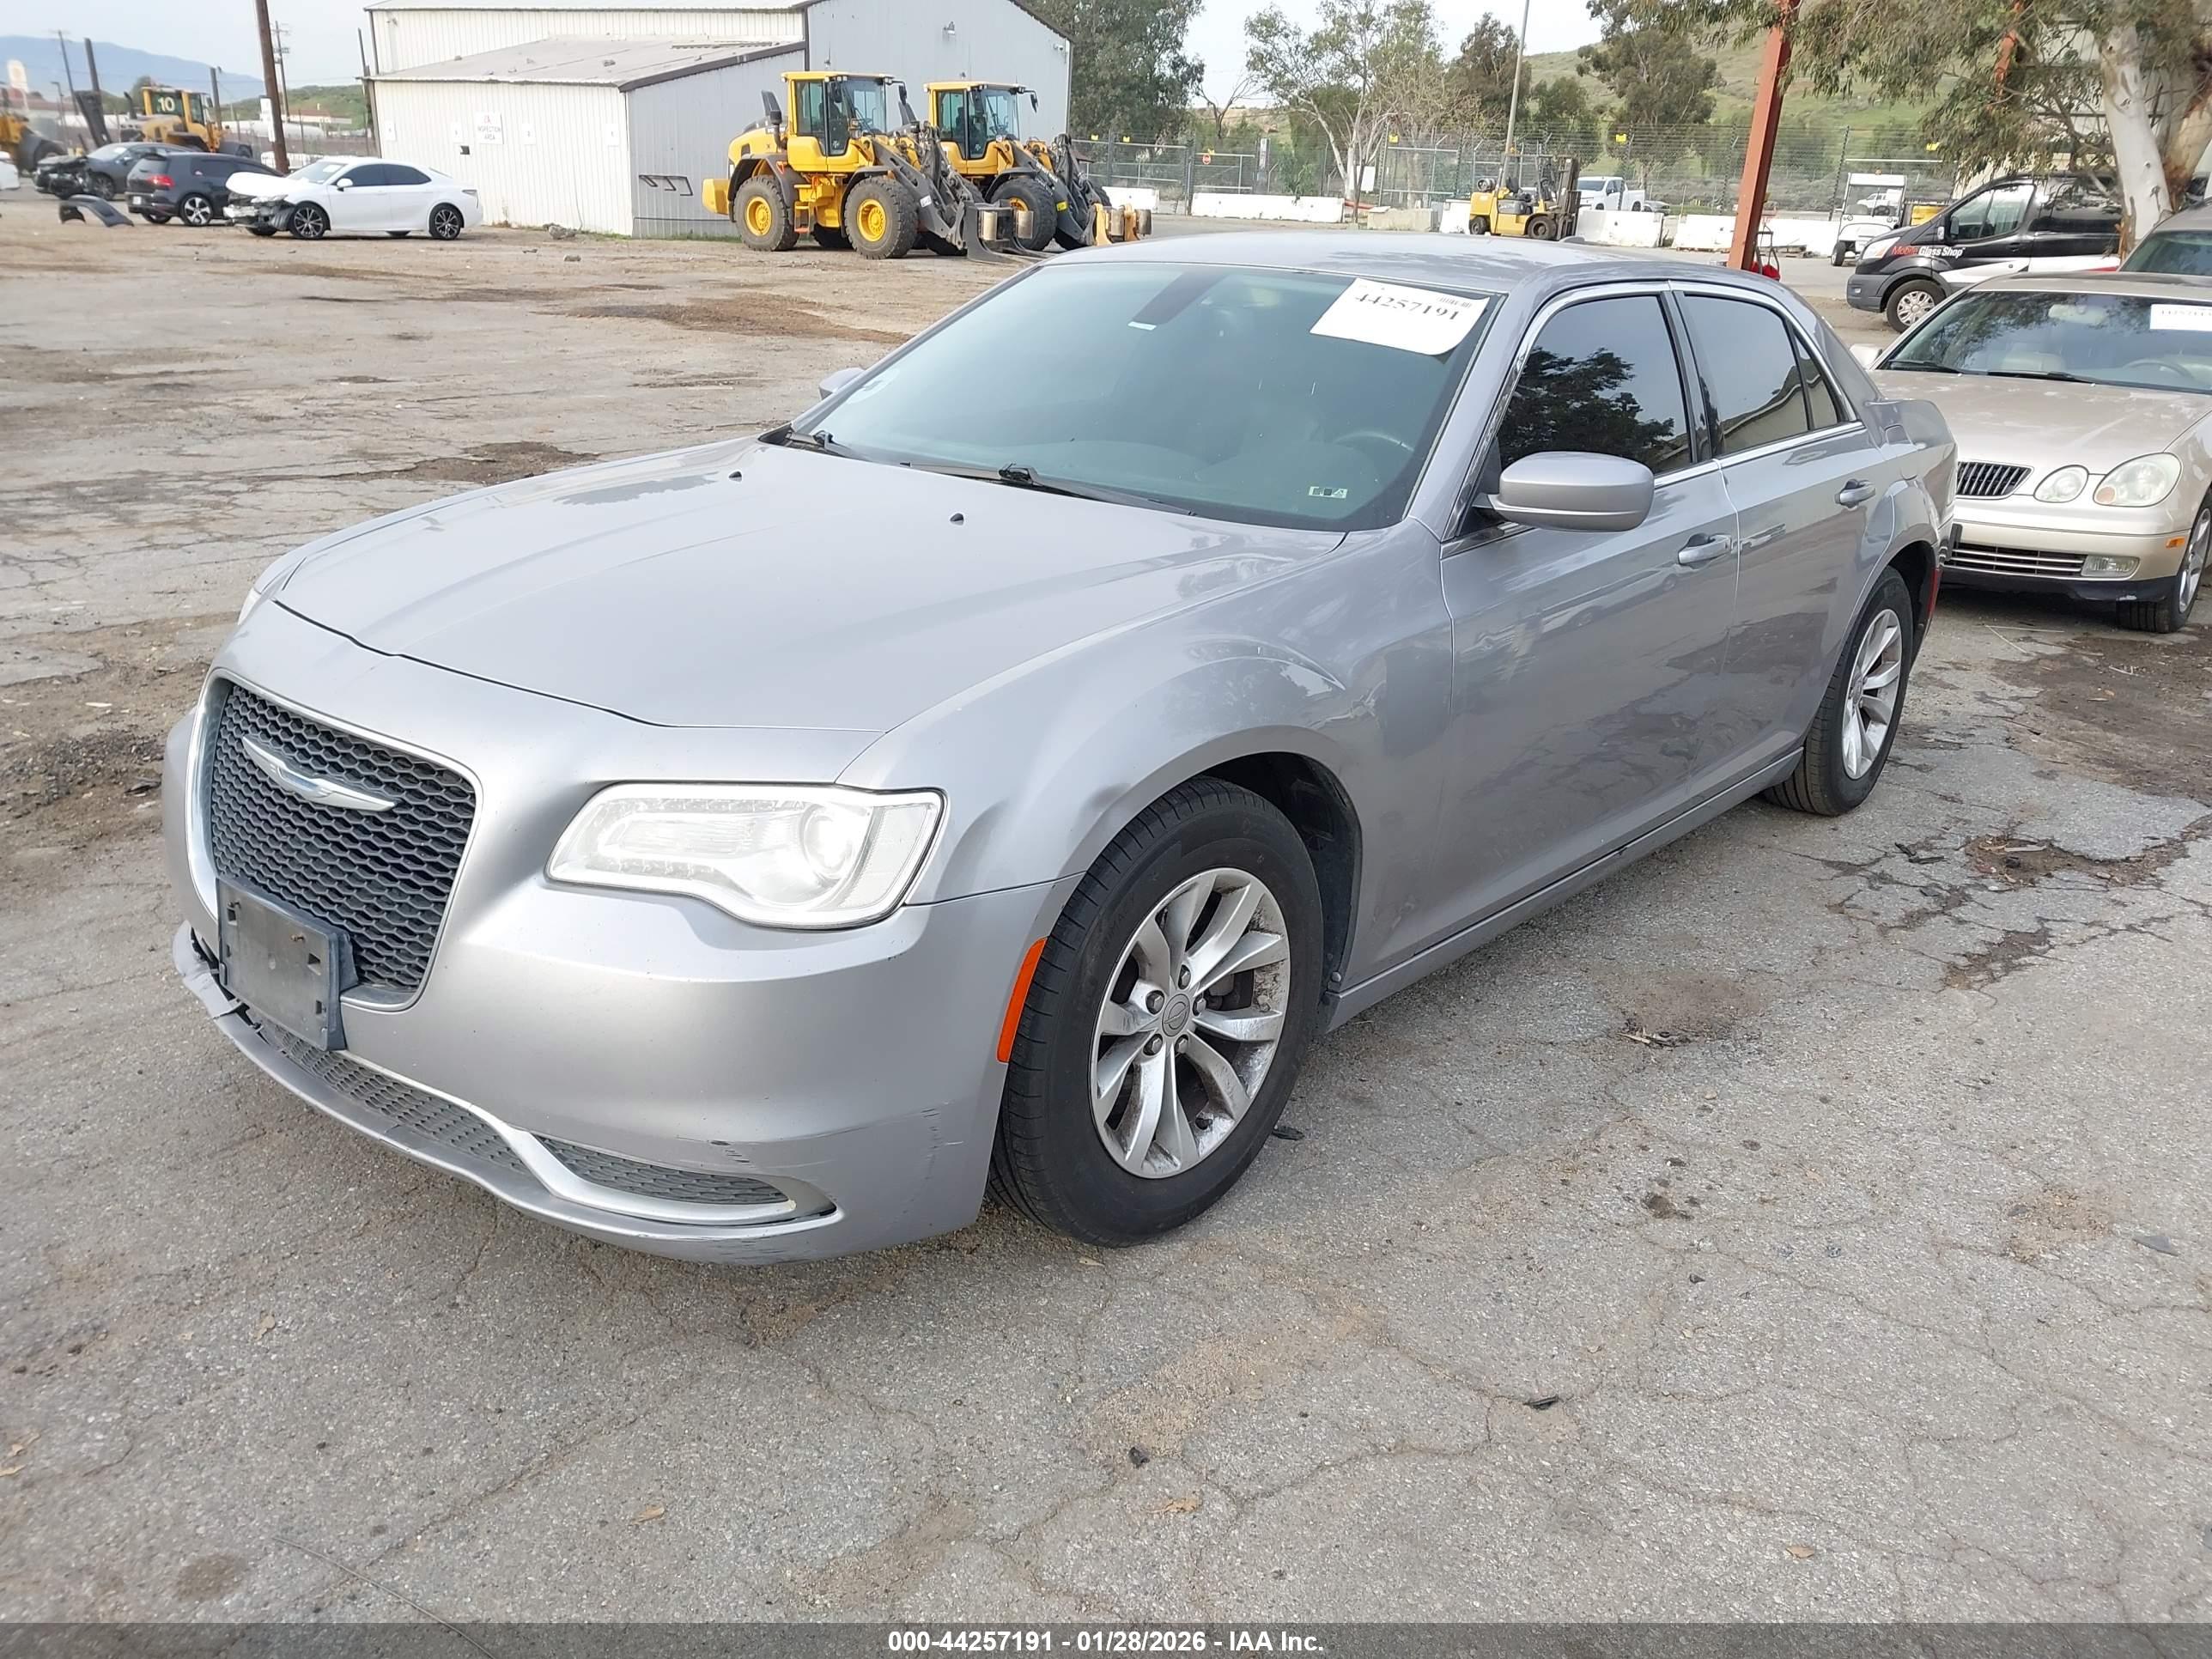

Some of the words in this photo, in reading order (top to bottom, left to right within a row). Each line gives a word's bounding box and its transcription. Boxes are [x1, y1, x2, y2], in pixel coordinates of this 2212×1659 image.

[157, 96, 176, 112] 10
[1892, 246, 1918, 255] Mobile
[1918, 246, 1942, 257] Glass
[1355, 293, 1460, 320] 44257191
